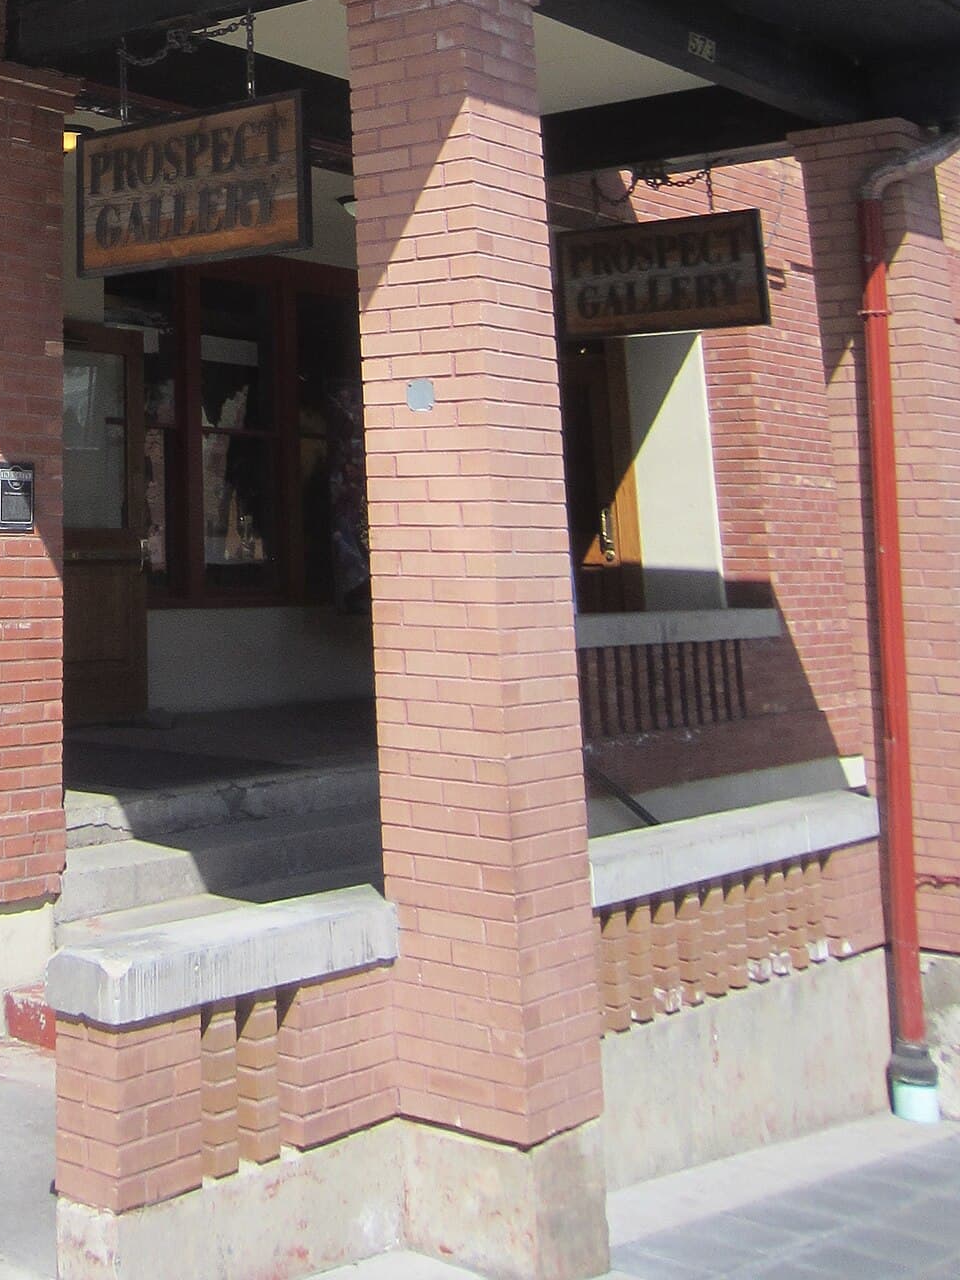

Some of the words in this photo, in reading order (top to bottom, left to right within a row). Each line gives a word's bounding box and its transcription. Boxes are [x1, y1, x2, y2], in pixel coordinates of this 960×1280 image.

[89, 115, 288, 195] PROSPECT
[95, 173, 280, 249] GALLERY
[568, 226, 746, 278] PROSPECT
[577, 272, 741, 320] GALLERY
